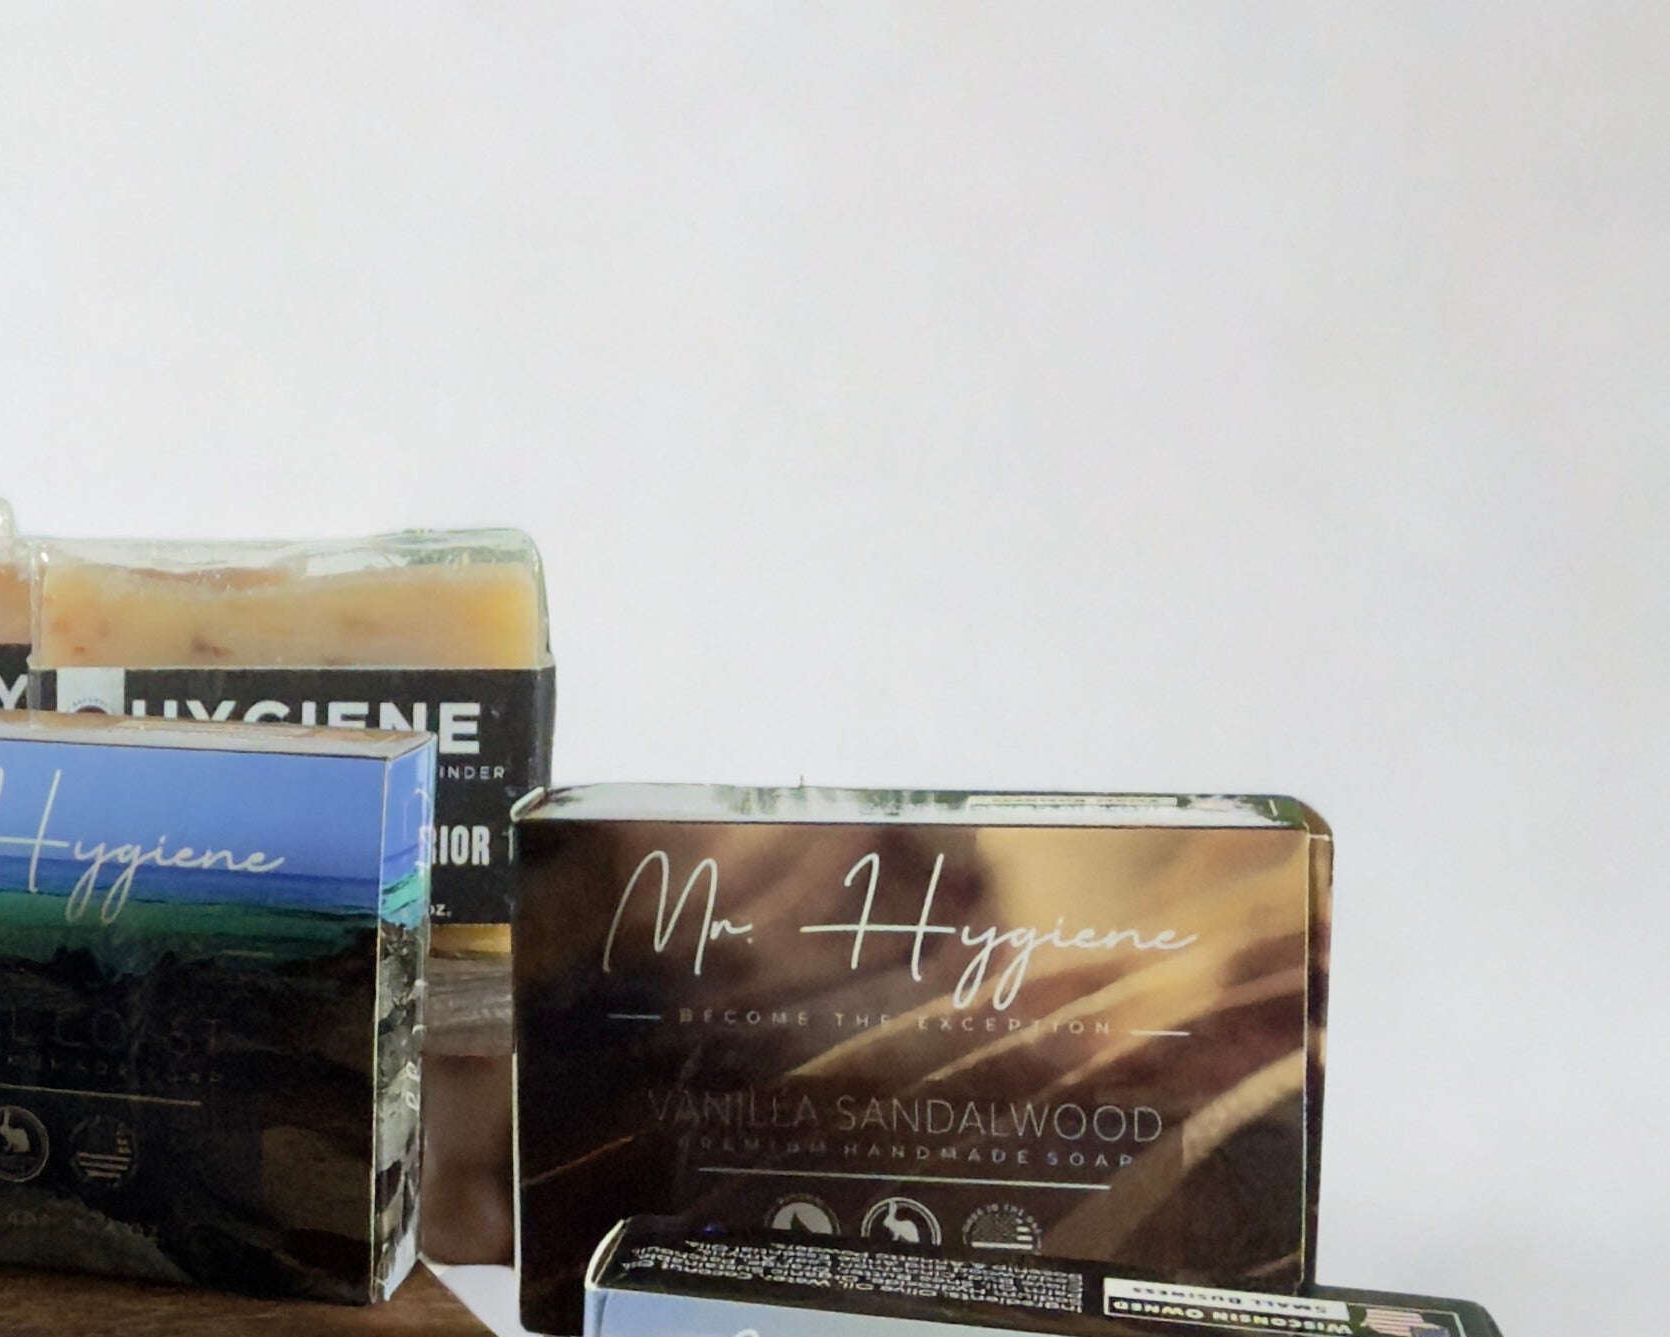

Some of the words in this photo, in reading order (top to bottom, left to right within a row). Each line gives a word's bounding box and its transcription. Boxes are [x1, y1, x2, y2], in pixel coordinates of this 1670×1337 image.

[439, 766, 505, 780] INDER
[602, 850, 752, 976] Mr.
[800, 852, 1199, 1011] Hygiene
[678, 1007, 809, 1027] BECOME
[834, 1012, 892, 1028] THE
[917, 1017, 1111, 1037] EXCEPTION
[648, 1088, 819, 1129] VANILLA
[834, 1094, 1162, 1145] SANDALWOOD
[842, 1143, 1030, 1165] HANDMADE
[1044, 1152, 1134, 1168] SOAP
[1113, 1301, 1205, 1320] OWNED
[1211, 1311, 1353, 1335] WISCONSIN
